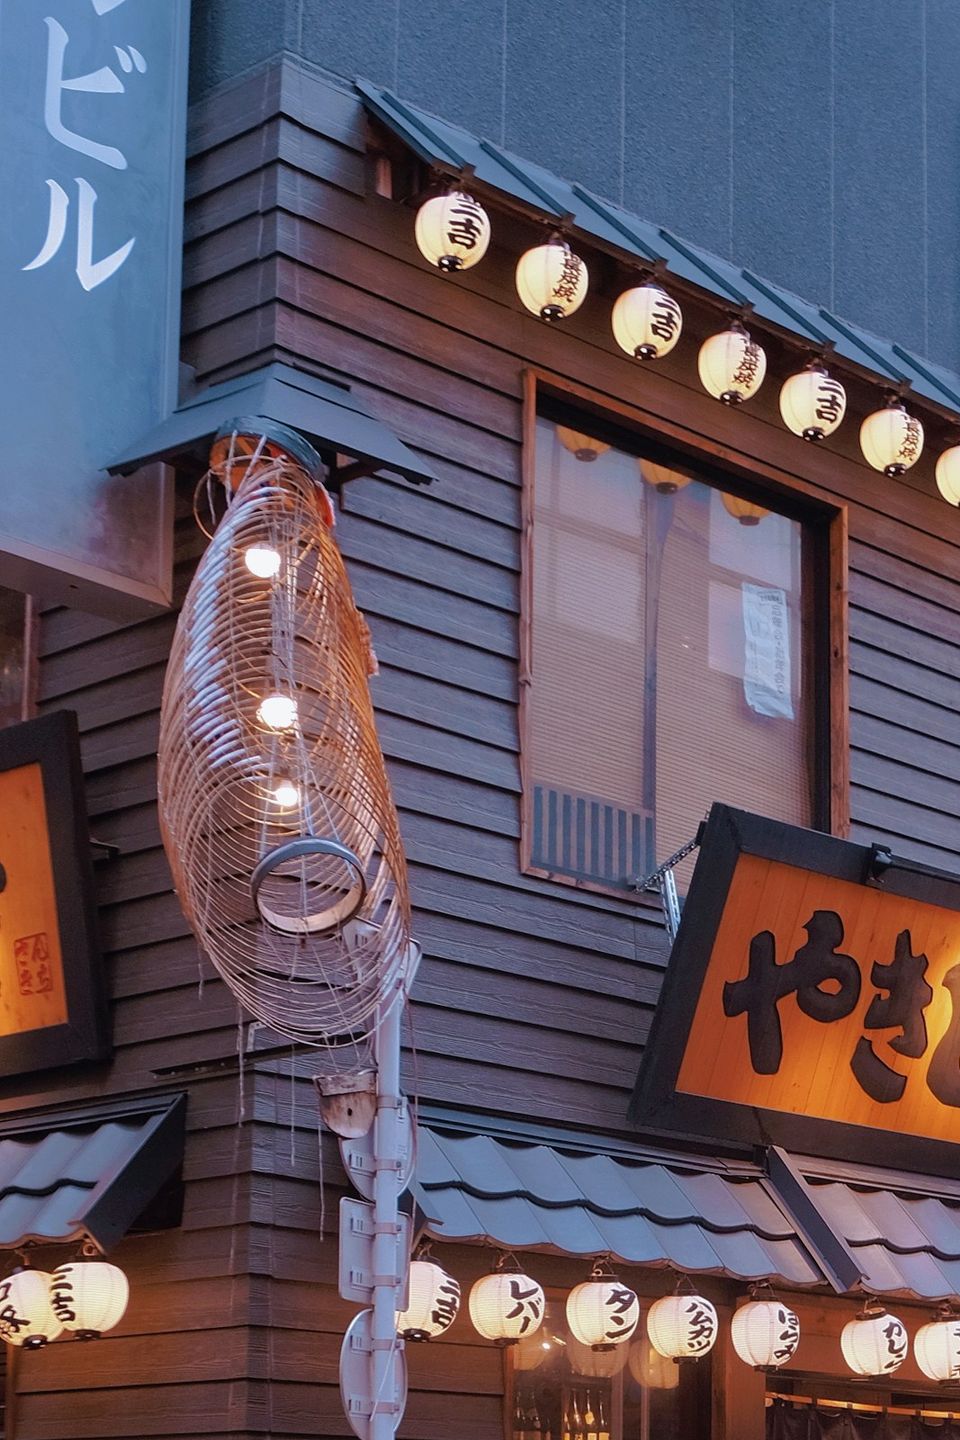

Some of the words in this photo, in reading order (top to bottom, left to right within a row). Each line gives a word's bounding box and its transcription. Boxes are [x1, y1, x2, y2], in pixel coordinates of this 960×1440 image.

[50, 1266, 76, 1323] 三吉
[505, 1278, 543, 1335] レバー
[604, 1287, 638, 1340] タン
[684, 1300, 717, 1354] ハムカツ
